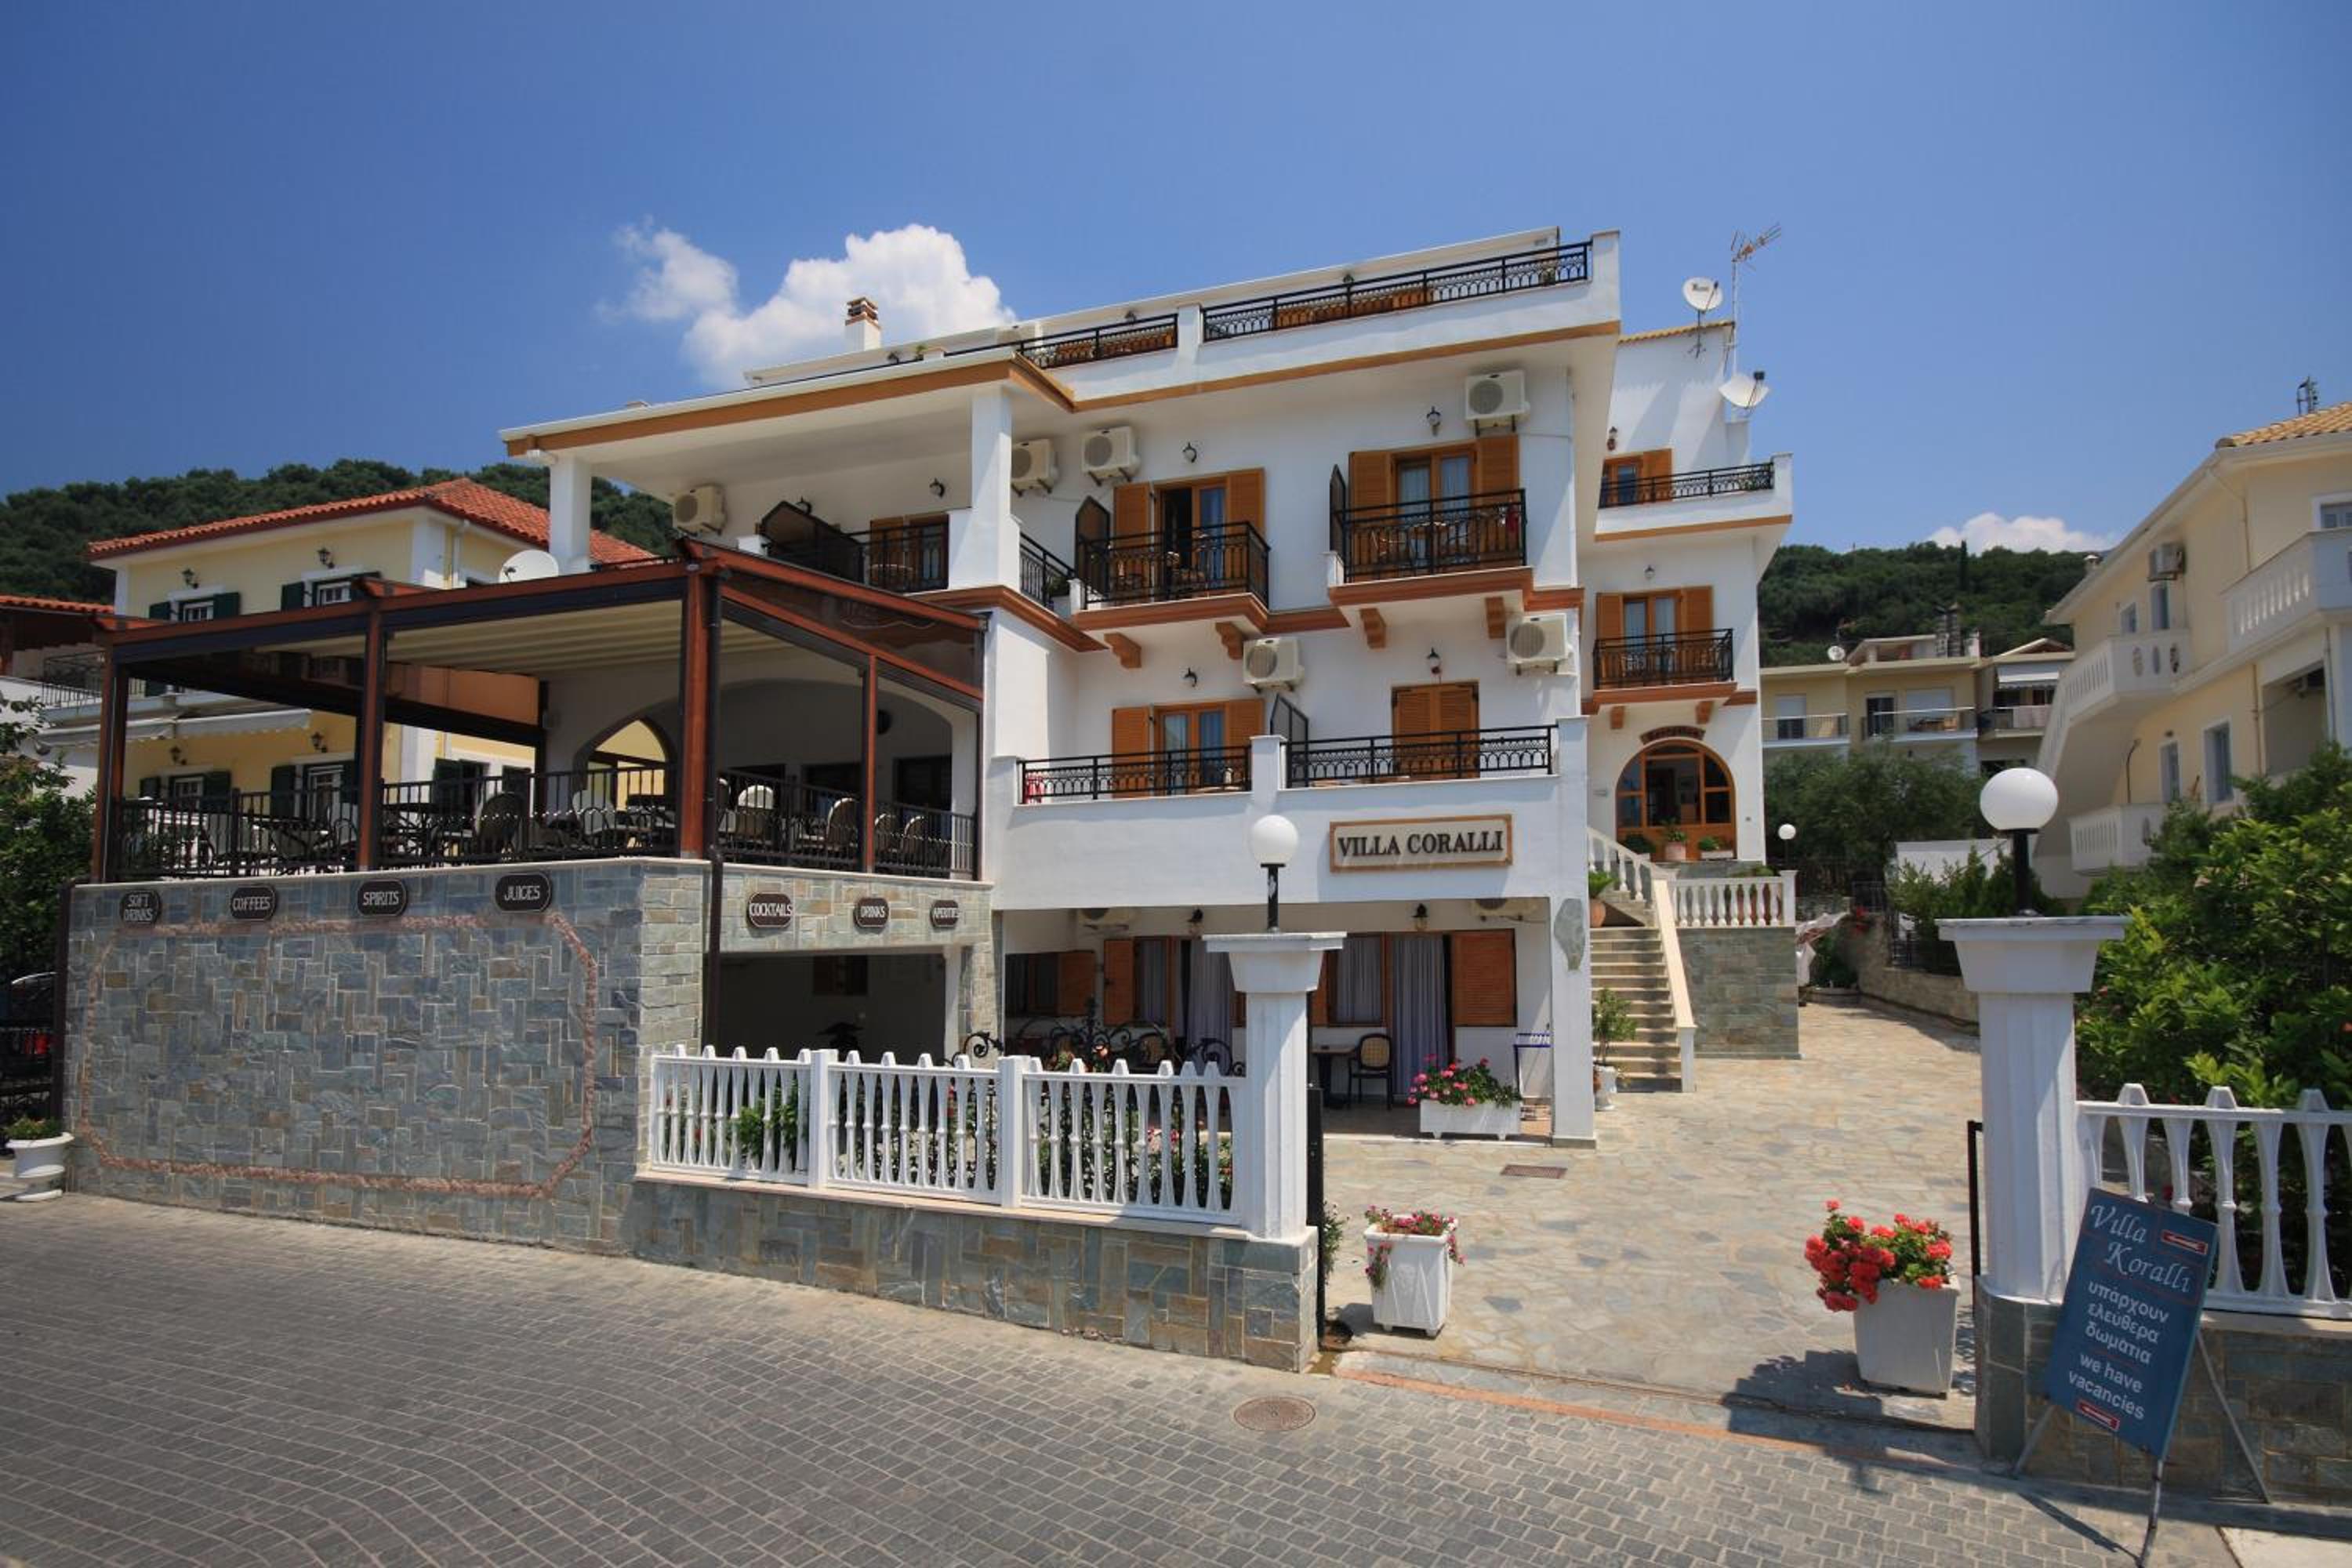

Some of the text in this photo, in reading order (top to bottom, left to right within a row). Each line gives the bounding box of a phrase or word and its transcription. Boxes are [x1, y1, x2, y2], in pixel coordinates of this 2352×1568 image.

[1338, 831, 1504, 857] VILLA CORALLI
[233, 896, 270, 912] COFFEES
[362, 891, 400, 906] SPIRITS
[504, 885, 540, 901] JUICES
[749, 902, 793, 916] COCKTAILS
[2091, 1205, 2147, 1243] Villa
[2104, 1241, 2191, 1293] Koralli
[2088, 1281, 2169, 1323] υπάρχουν
[2079, 1353, 2143, 1393] we have
[2068, 1370, 2145, 1420] vacancies
